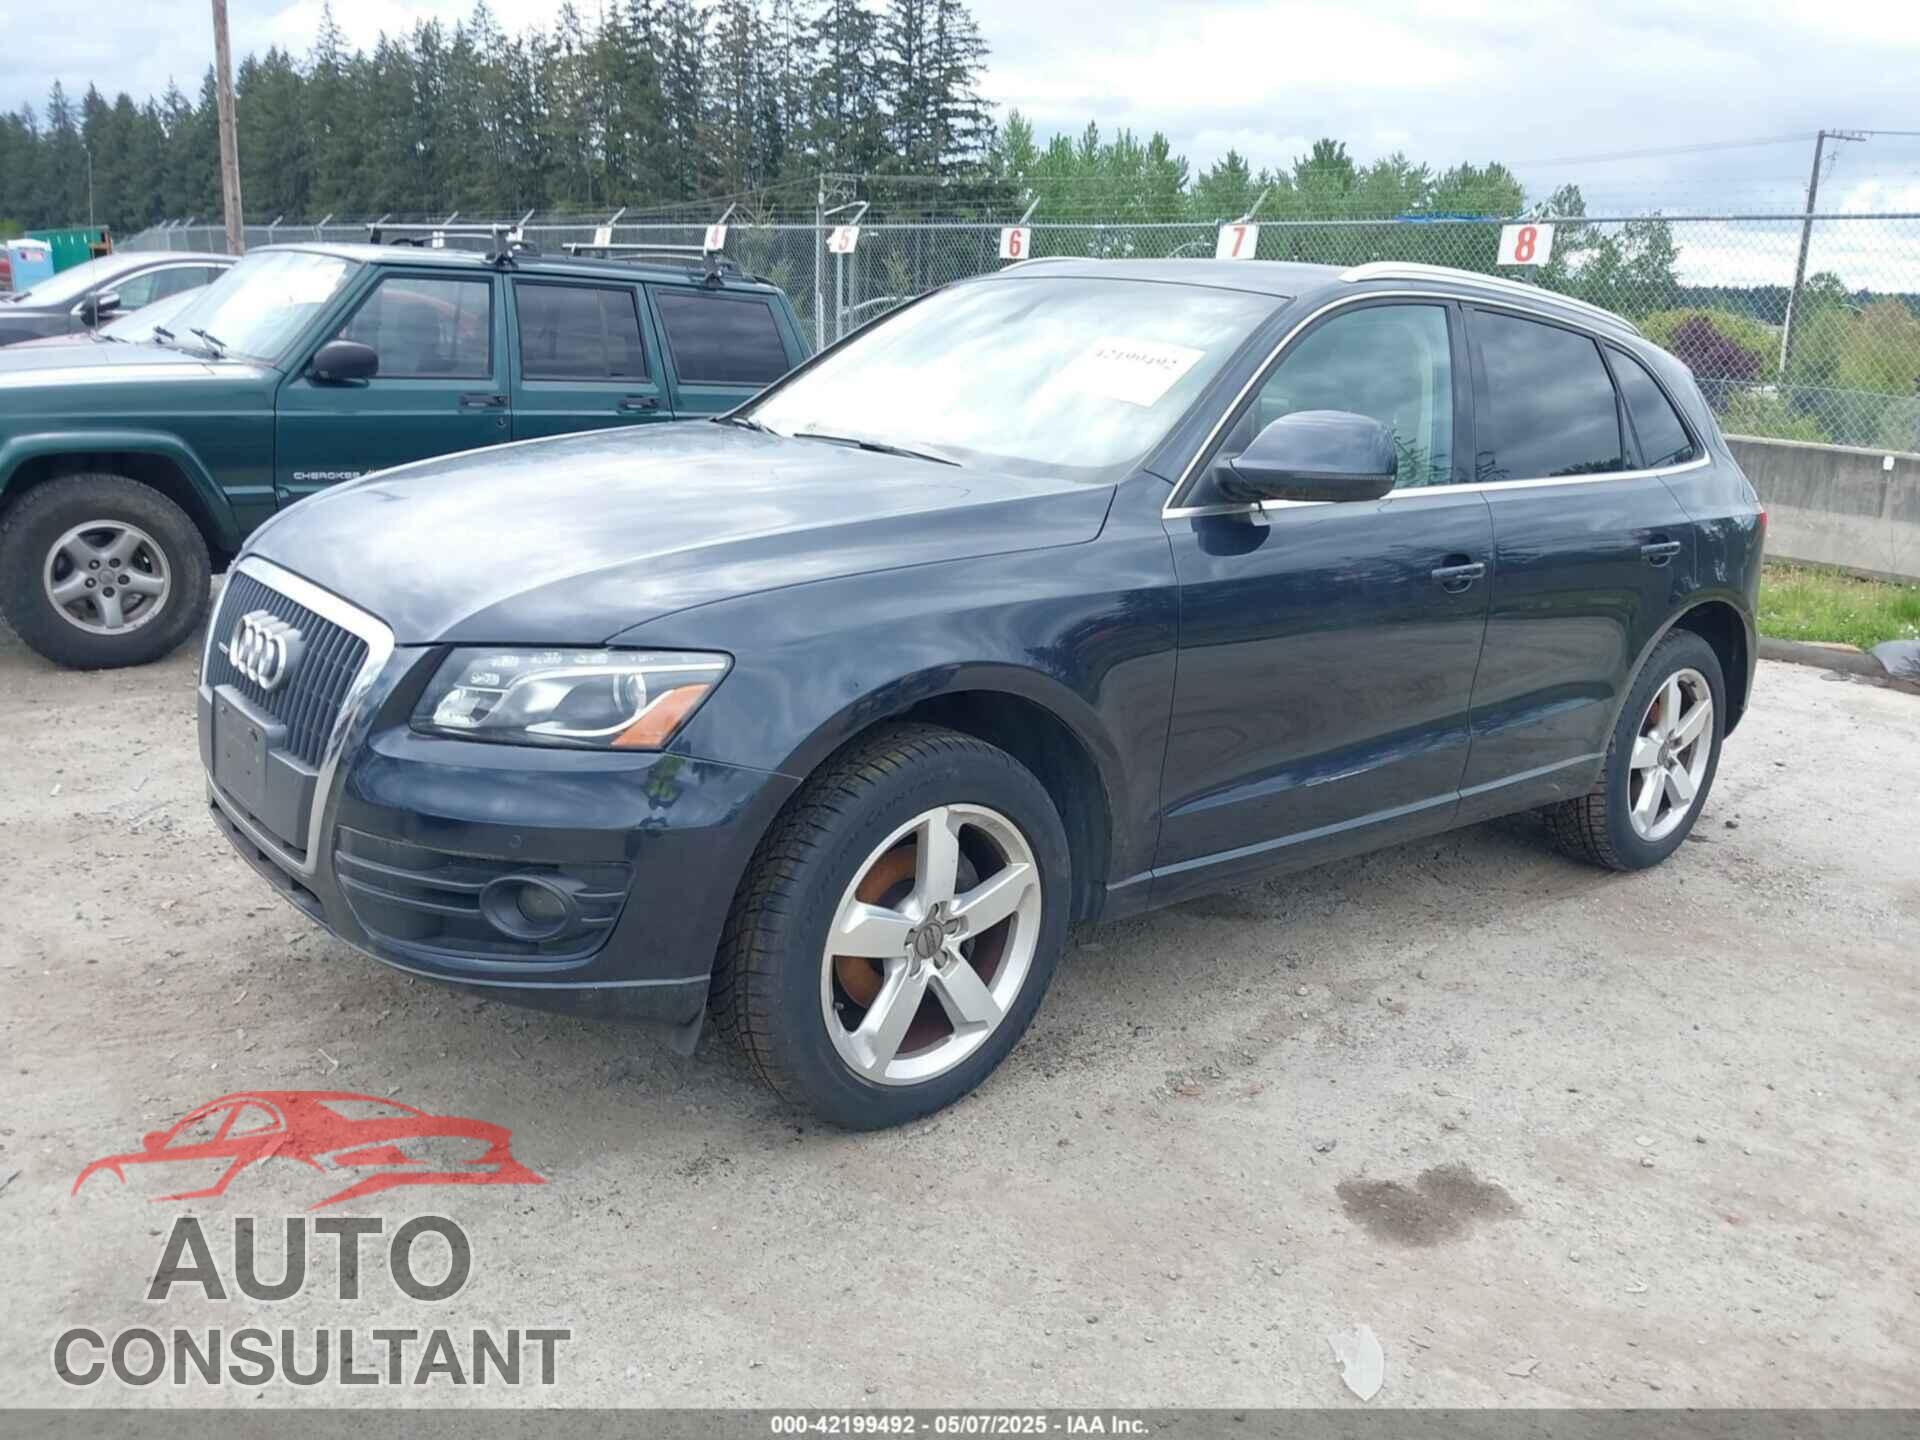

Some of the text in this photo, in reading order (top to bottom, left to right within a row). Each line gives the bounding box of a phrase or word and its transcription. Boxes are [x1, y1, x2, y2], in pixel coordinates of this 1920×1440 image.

[838, 228, 849, 251] 5
[1009, 229, 1022, 258] 6
[1231, 226, 1247, 257] 7
[1514, 226, 1537, 262] 8
[293, 471, 360, 480] CHEROKEE
